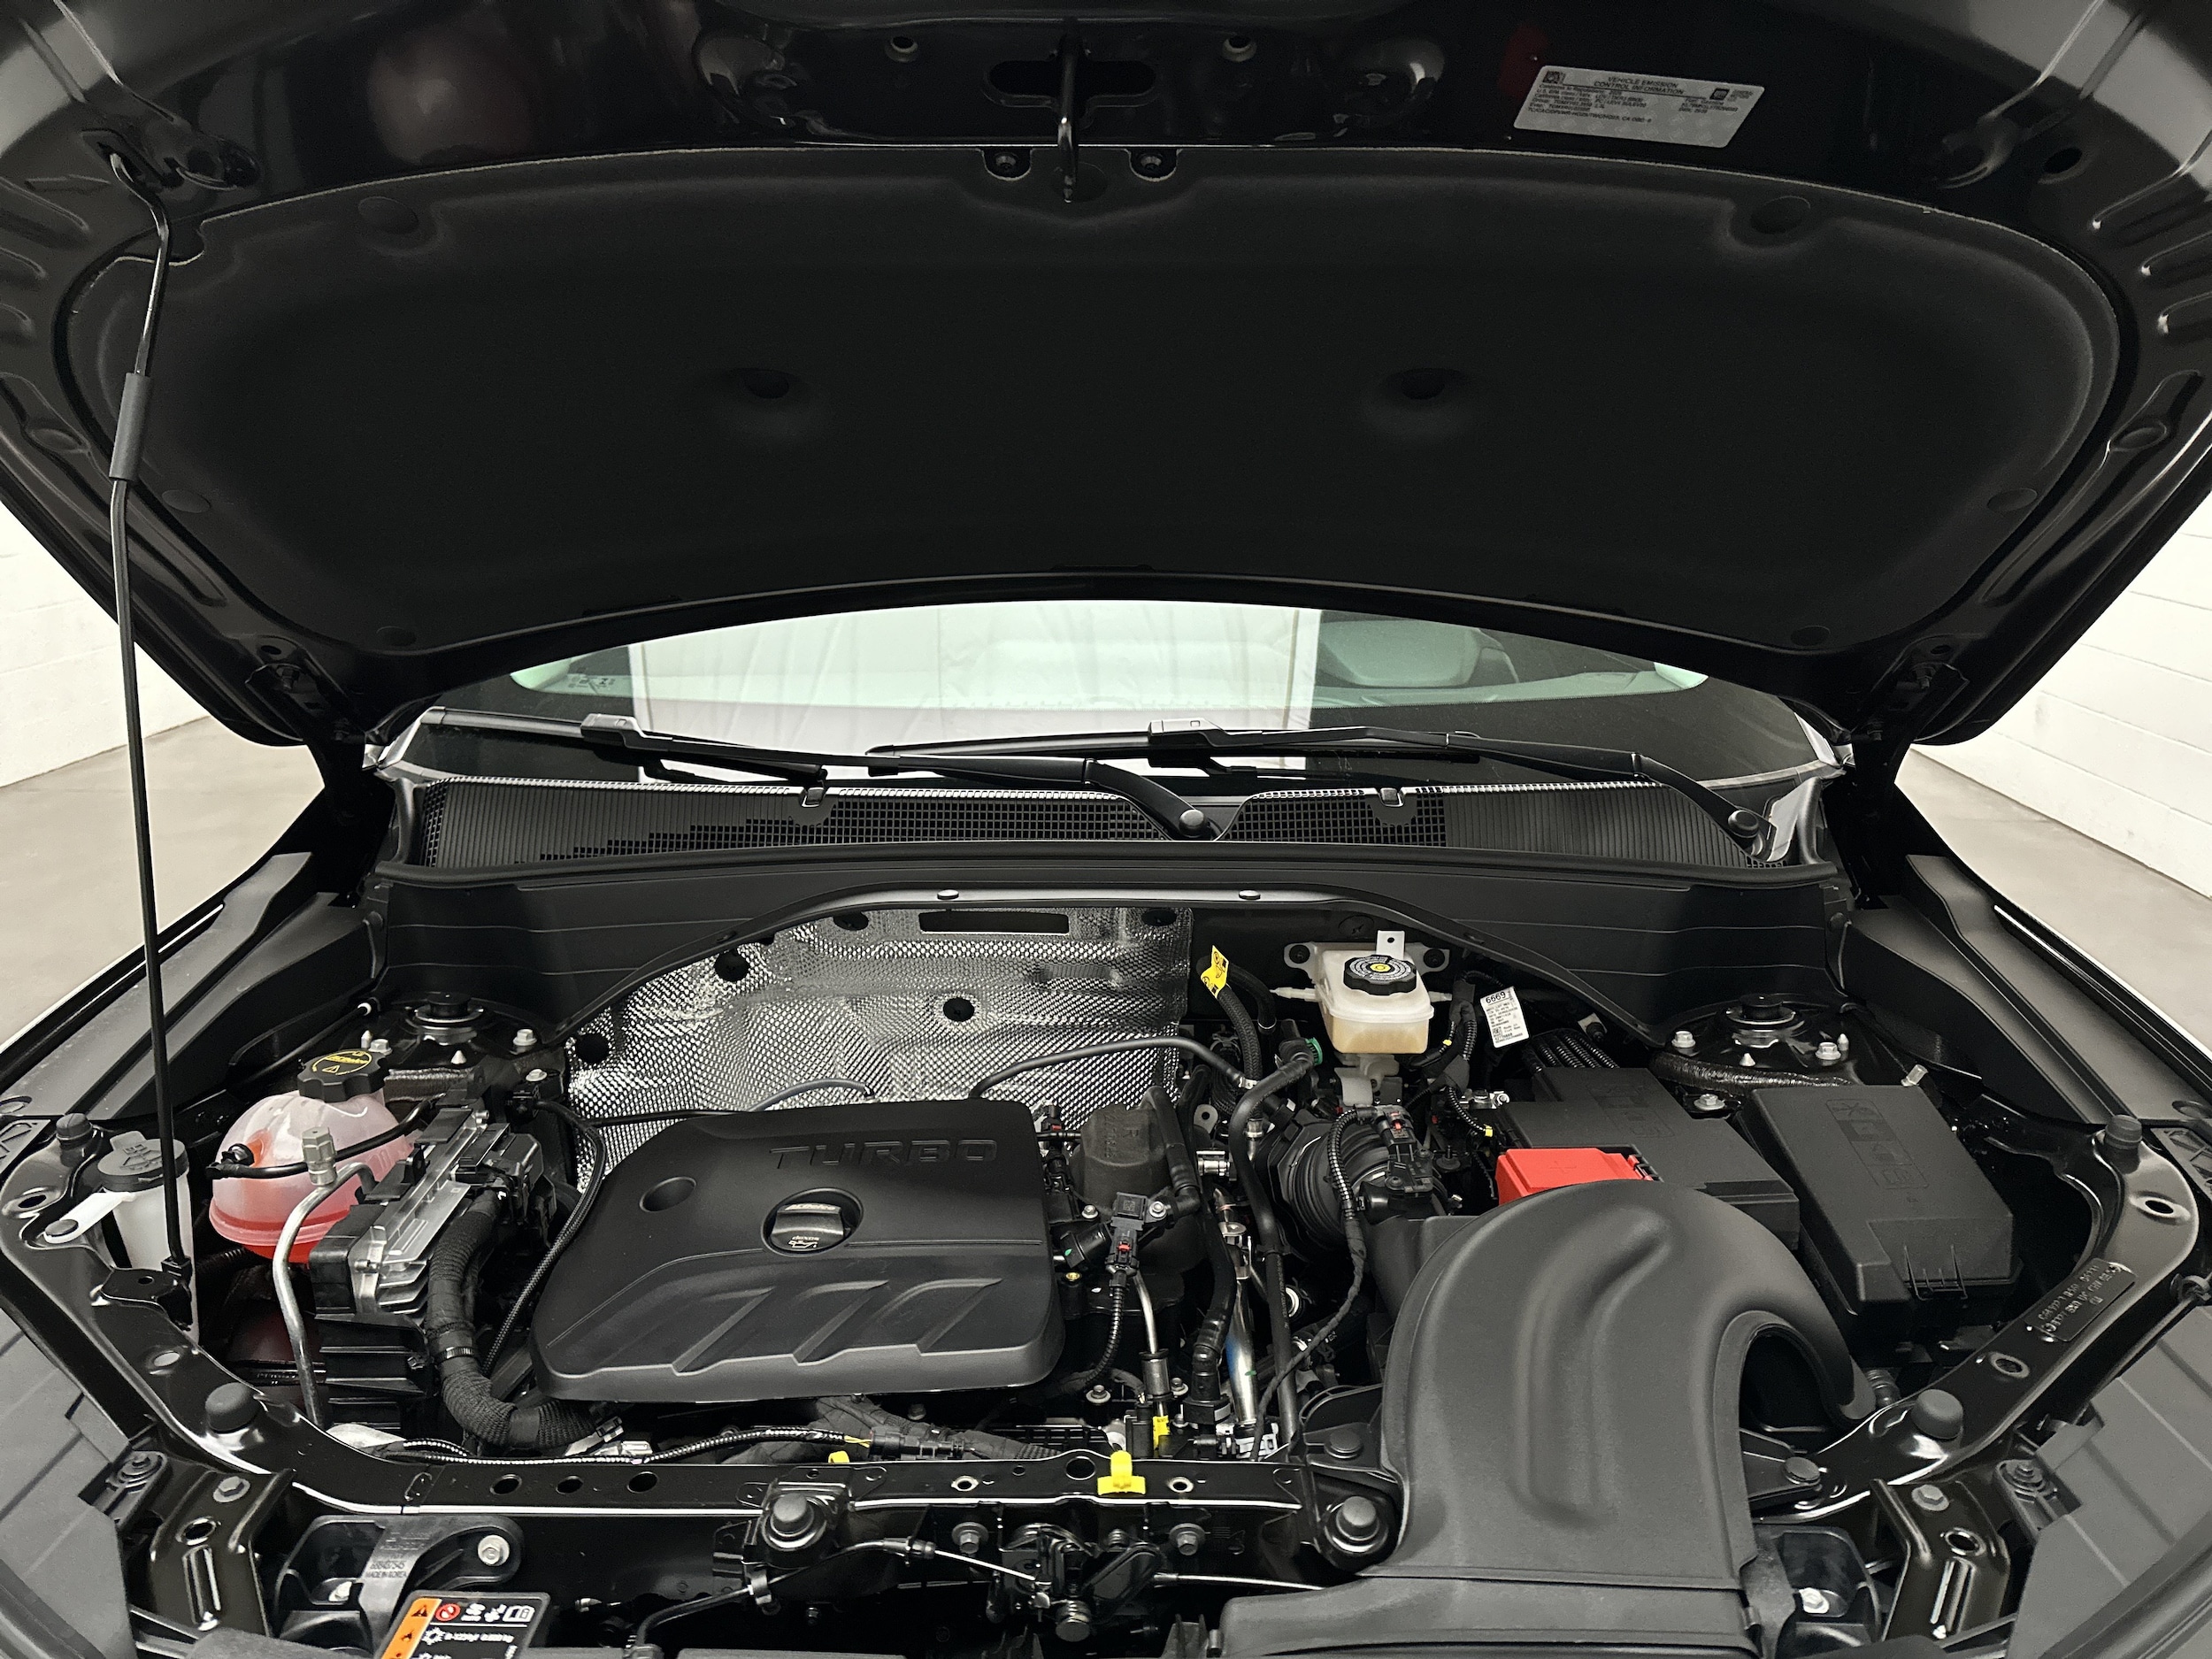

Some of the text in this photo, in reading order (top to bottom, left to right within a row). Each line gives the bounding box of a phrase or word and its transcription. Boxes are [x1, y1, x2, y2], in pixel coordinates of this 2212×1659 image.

[1594, 81, 1629, 90] CONTROL
[1632, 85, 1685, 95] INFORMATION
[1641, 80, 1678, 88] EMISSION
[1485, 991, 1506, 1004] 6669
[768, 1138, 998, 1169] TURBO
